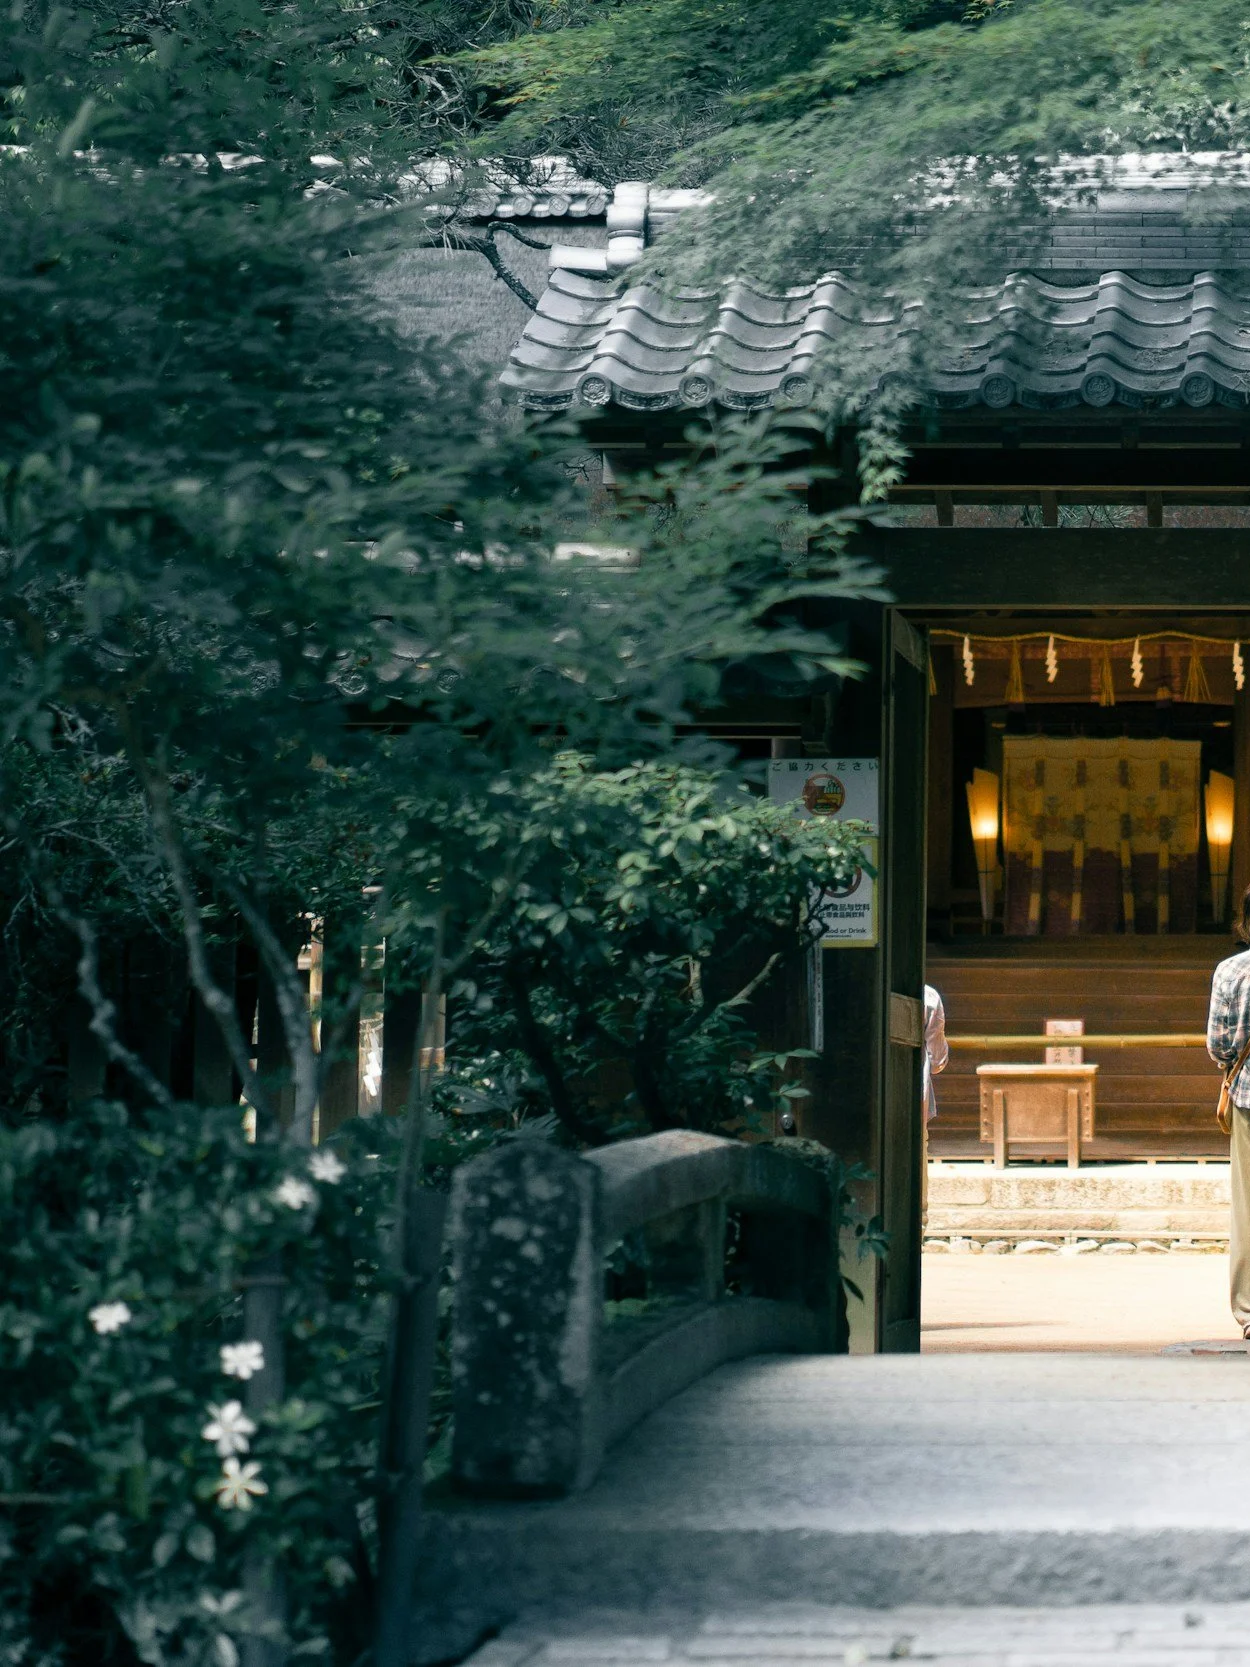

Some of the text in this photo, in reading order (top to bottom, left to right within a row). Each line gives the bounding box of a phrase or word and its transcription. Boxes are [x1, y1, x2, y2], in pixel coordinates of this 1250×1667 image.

[772, 762, 879, 772] ご協力ください
